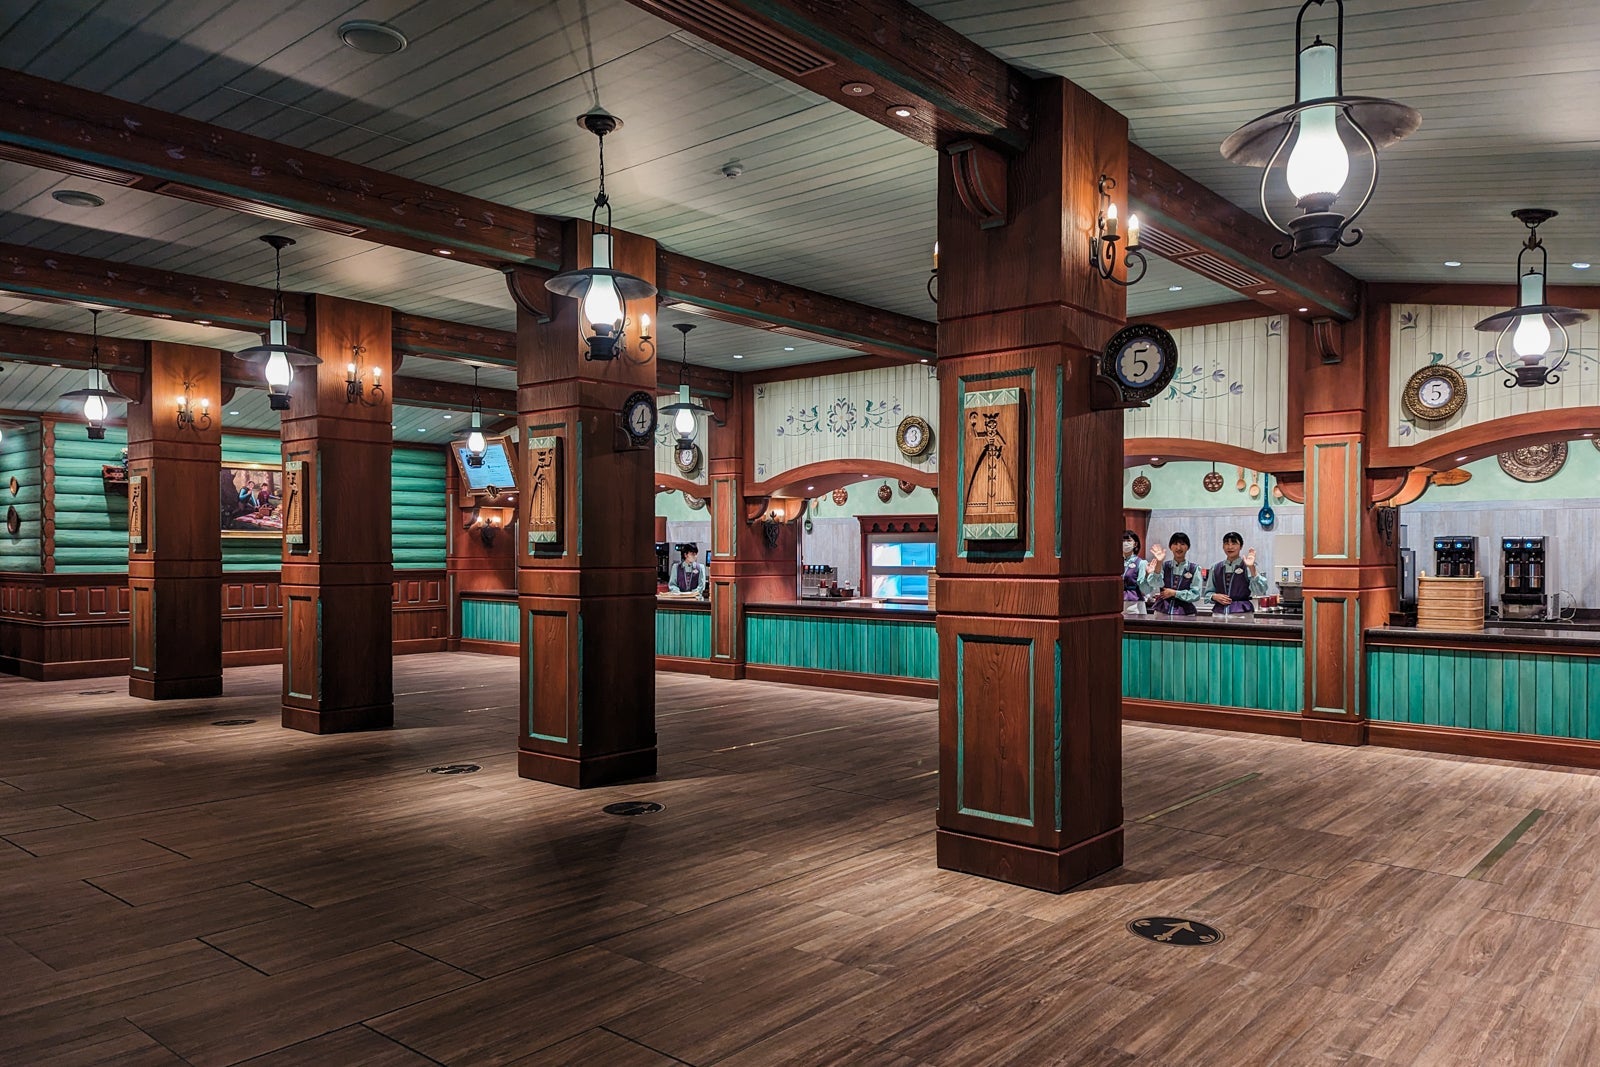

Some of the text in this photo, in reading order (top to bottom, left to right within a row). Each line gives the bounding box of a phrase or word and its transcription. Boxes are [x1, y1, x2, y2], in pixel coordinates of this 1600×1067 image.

[1133, 348, 1149, 378] 5
[1431, 384, 1442, 401] 5
[636, 408, 647, 429] 4
[910, 430, 918, 443] 3
